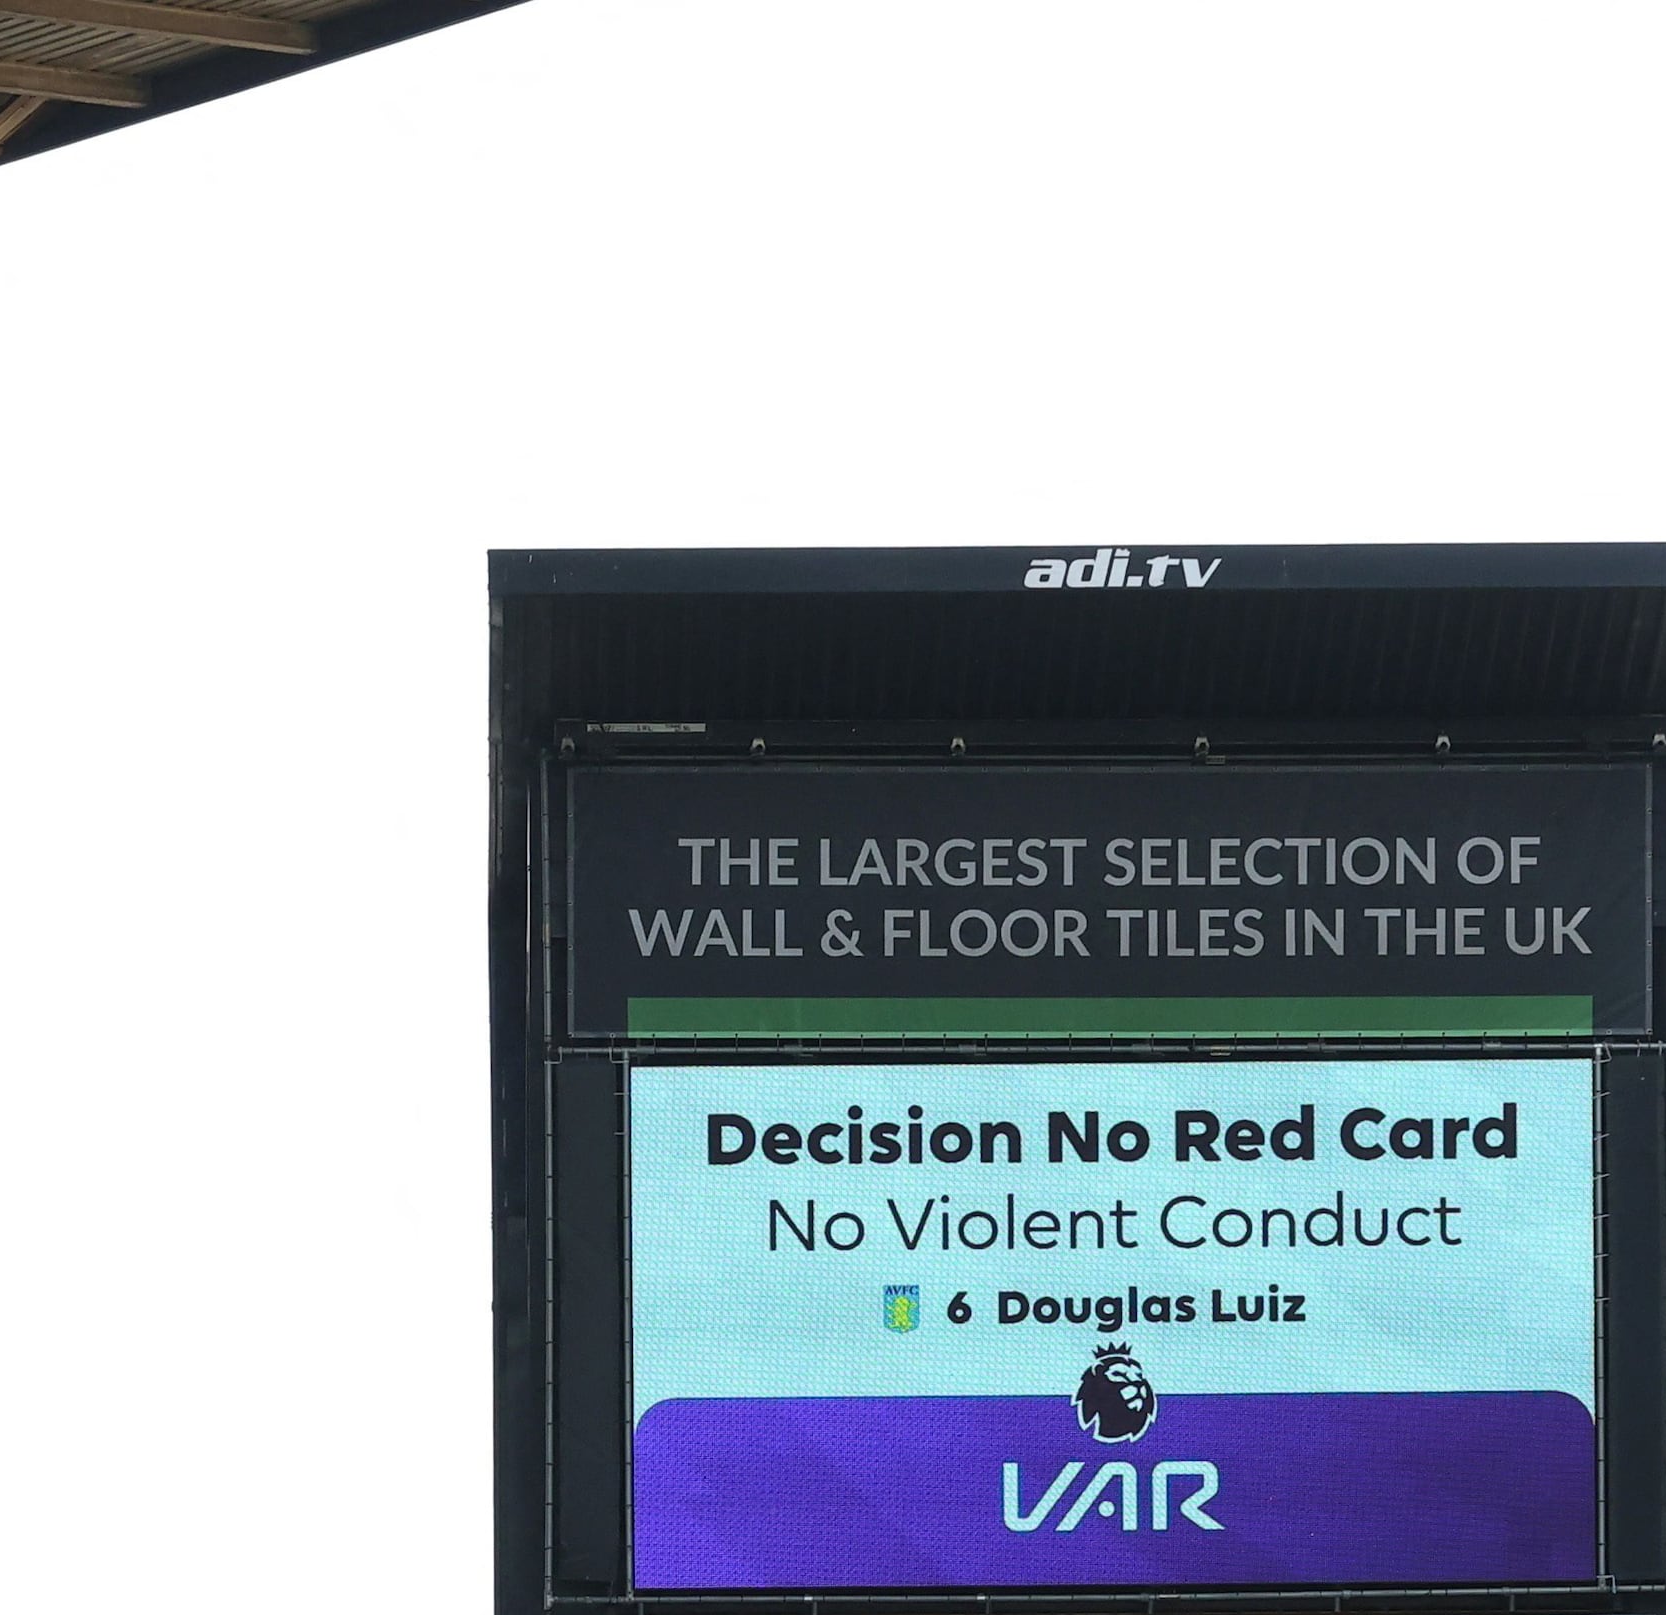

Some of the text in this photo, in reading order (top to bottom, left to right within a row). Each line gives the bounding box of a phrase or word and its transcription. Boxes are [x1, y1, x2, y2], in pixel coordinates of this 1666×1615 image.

[1023, 548, 1223, 588] adi.tv
[678, 836, 1541, 887] THE LARGEST SELECTION OF
[629, 906, 1593, 957] WALL & FLOOR TILES IN THE UK
[707, 1102, 1518, 1165] Decision No Red Card
[768, 1190, 1463, 1251] No Violent Conduct
[947, 1284, 1307, 1333] 6 Douglas Luiz
[1001, 1461, 1226, 1532] VAR
